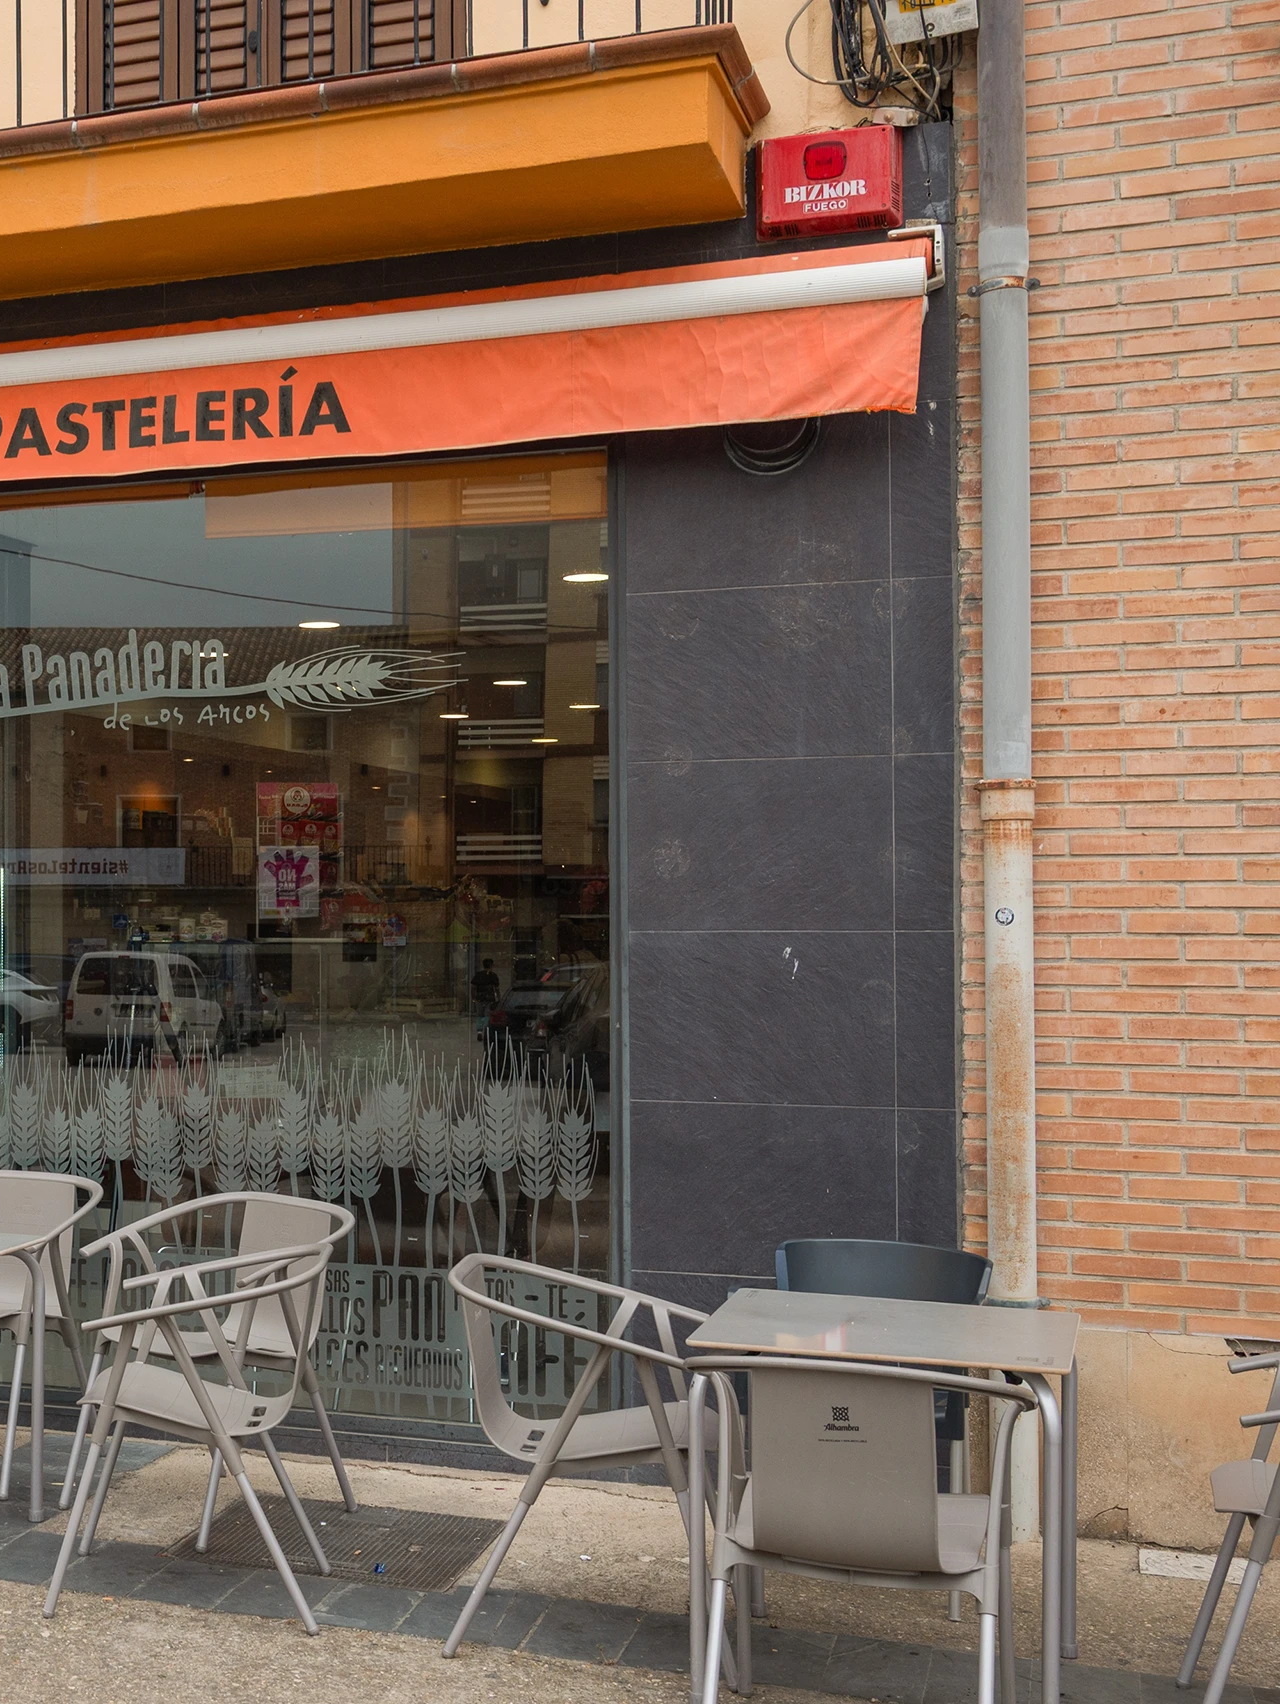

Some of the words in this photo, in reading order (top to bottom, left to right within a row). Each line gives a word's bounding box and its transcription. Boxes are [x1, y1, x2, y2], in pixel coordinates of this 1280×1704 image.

[784, 179, 867, 204] BIZKOR
[804, 200, 847, 213] FUEGO
[103, 702, 133, 731] de
[372, 1269, 446, 1343] PAN
[374, 1343, 463, 1390] RECUERDOS
[823, 1423, 860, 1432] Alhambra
